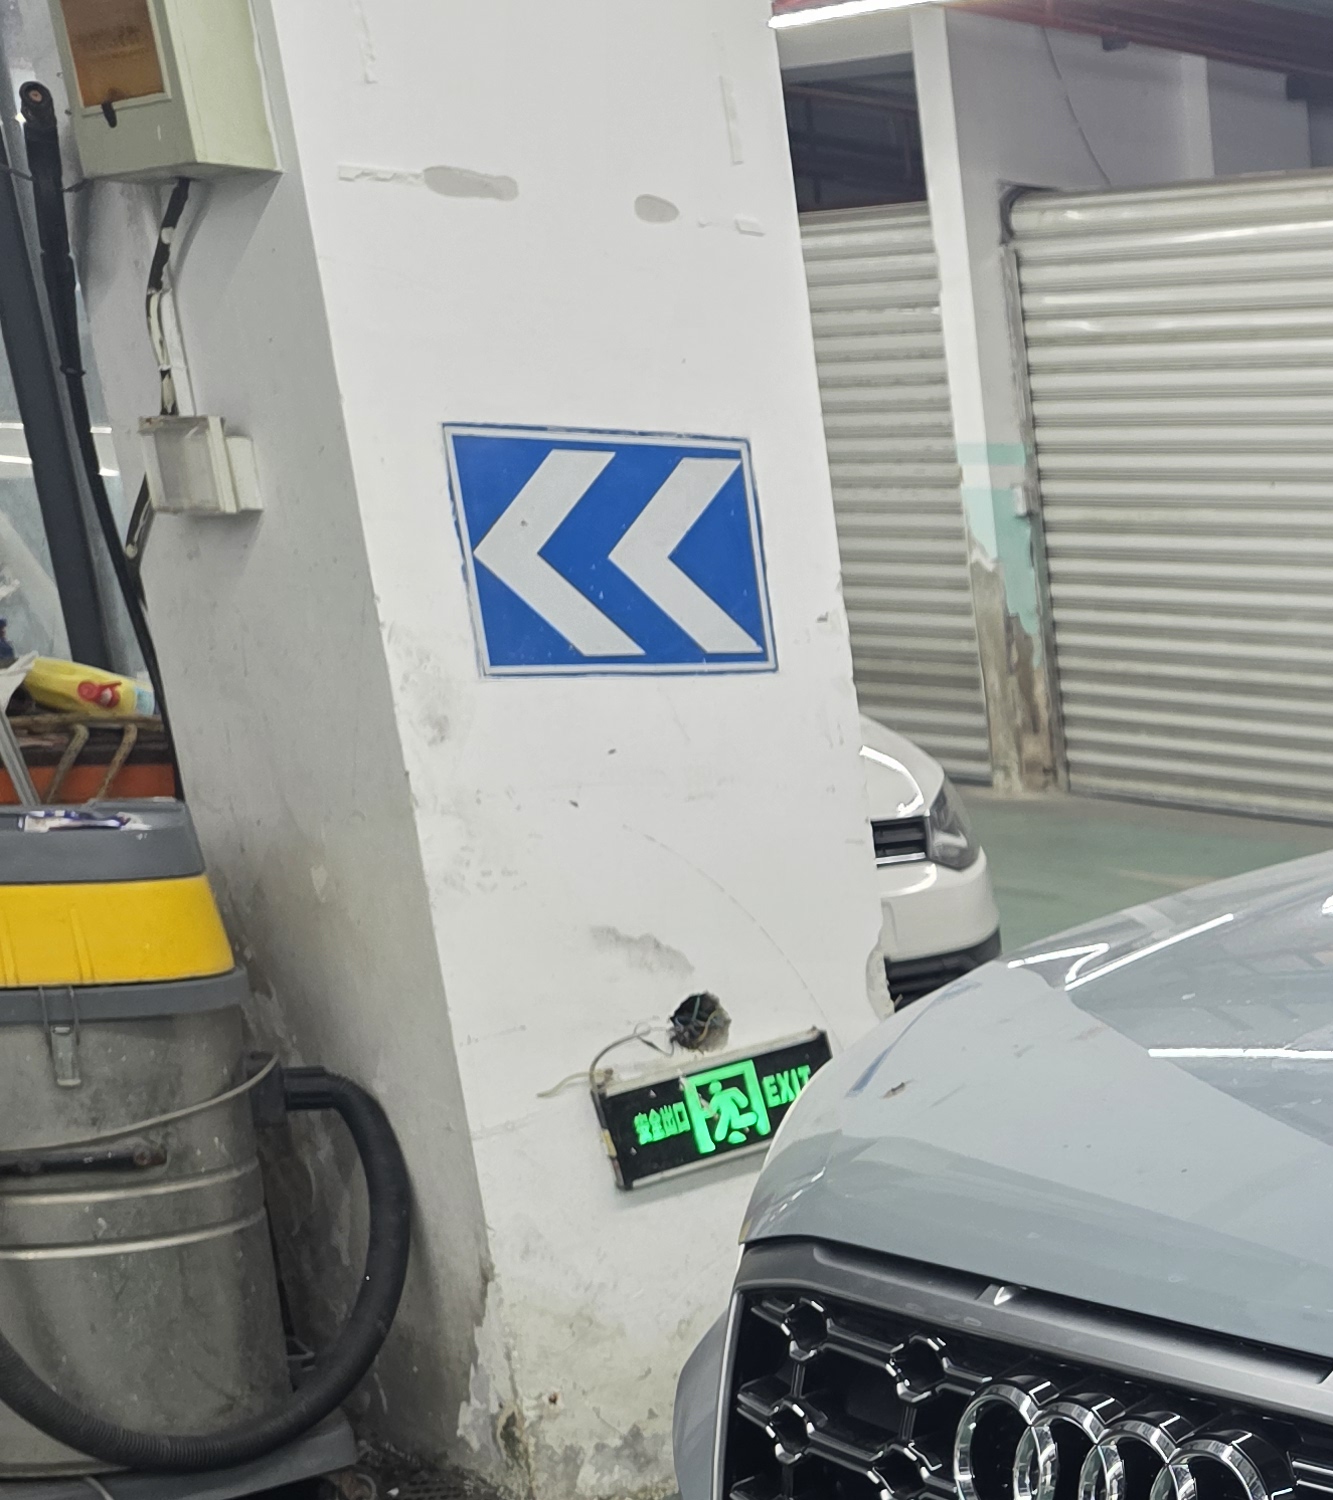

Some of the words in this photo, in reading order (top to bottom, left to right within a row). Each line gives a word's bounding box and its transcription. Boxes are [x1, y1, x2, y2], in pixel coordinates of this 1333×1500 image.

[762, 1065, 811, 1108] EXIT
[634, 1101, 690, 1145] 安全出口
